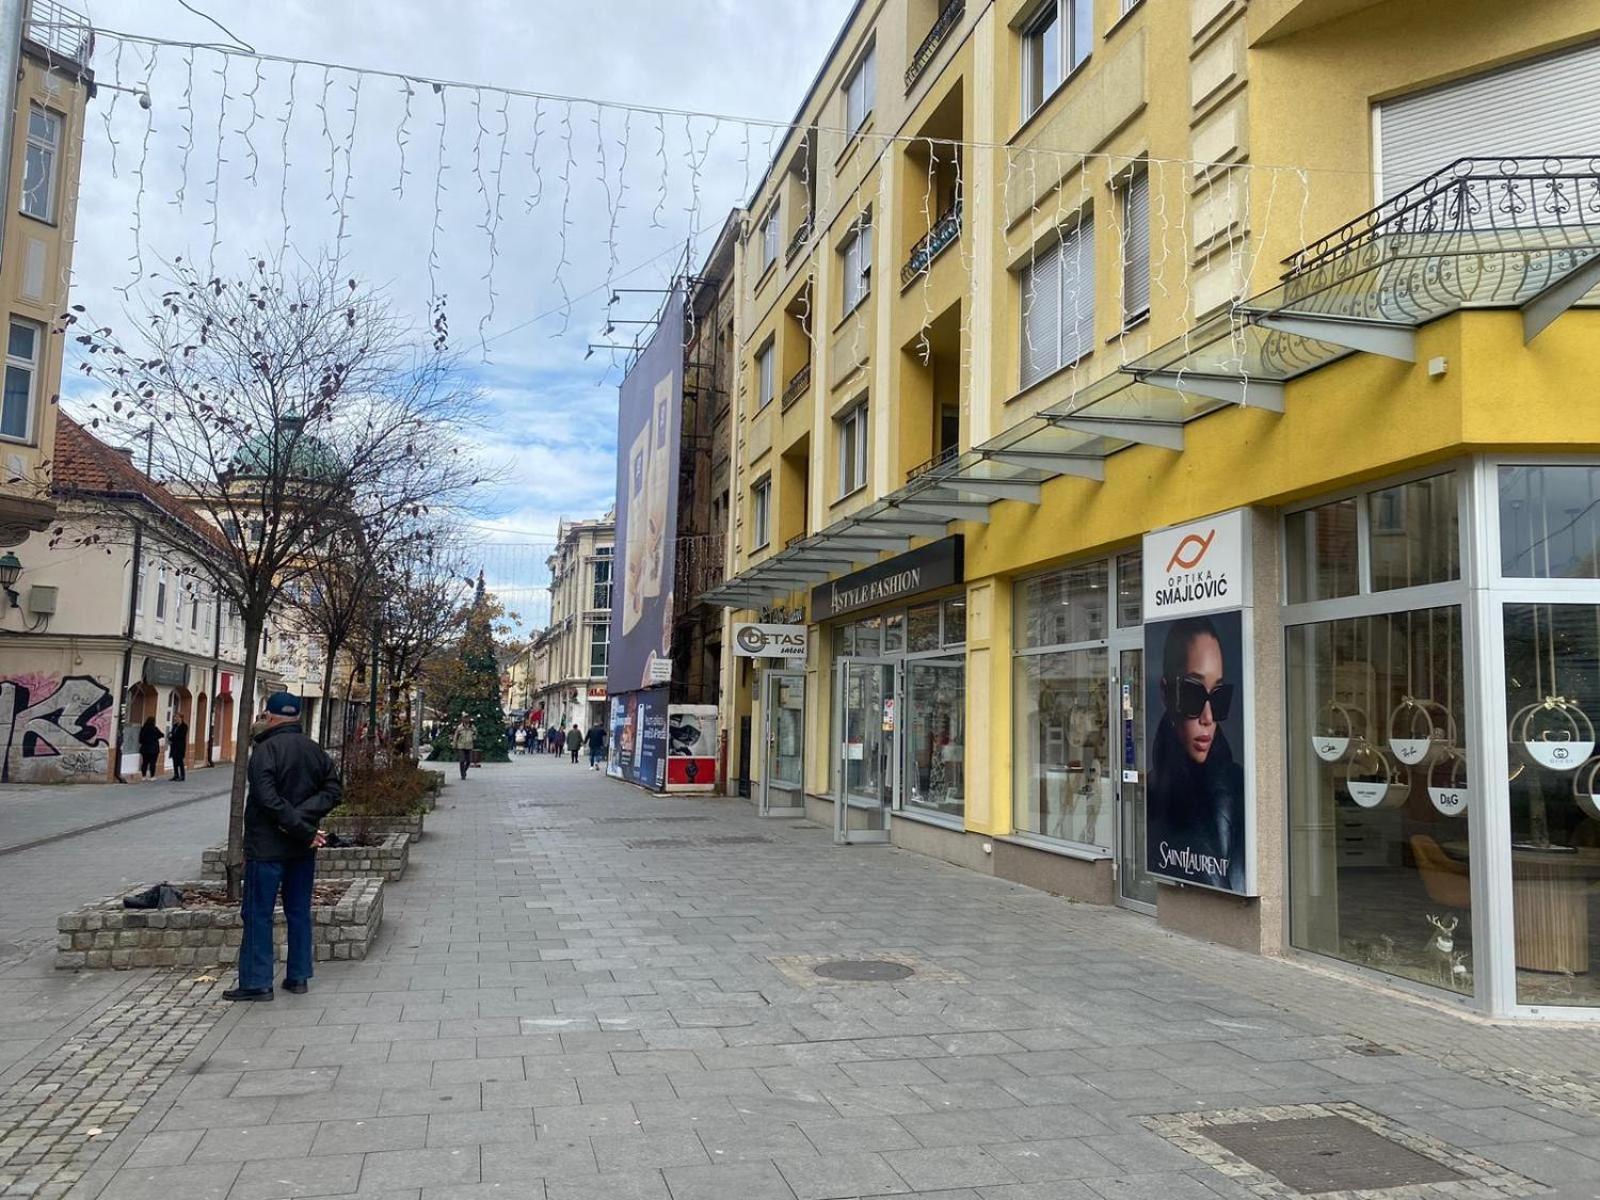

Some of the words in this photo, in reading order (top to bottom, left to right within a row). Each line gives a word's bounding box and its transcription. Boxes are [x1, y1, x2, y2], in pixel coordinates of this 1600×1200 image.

[870, 567, 920, 600] FASHION
[1156, 574, 1227, 606] SMAJLOVIĆ
[1168, 570, 1212, 587] OPTIKA
